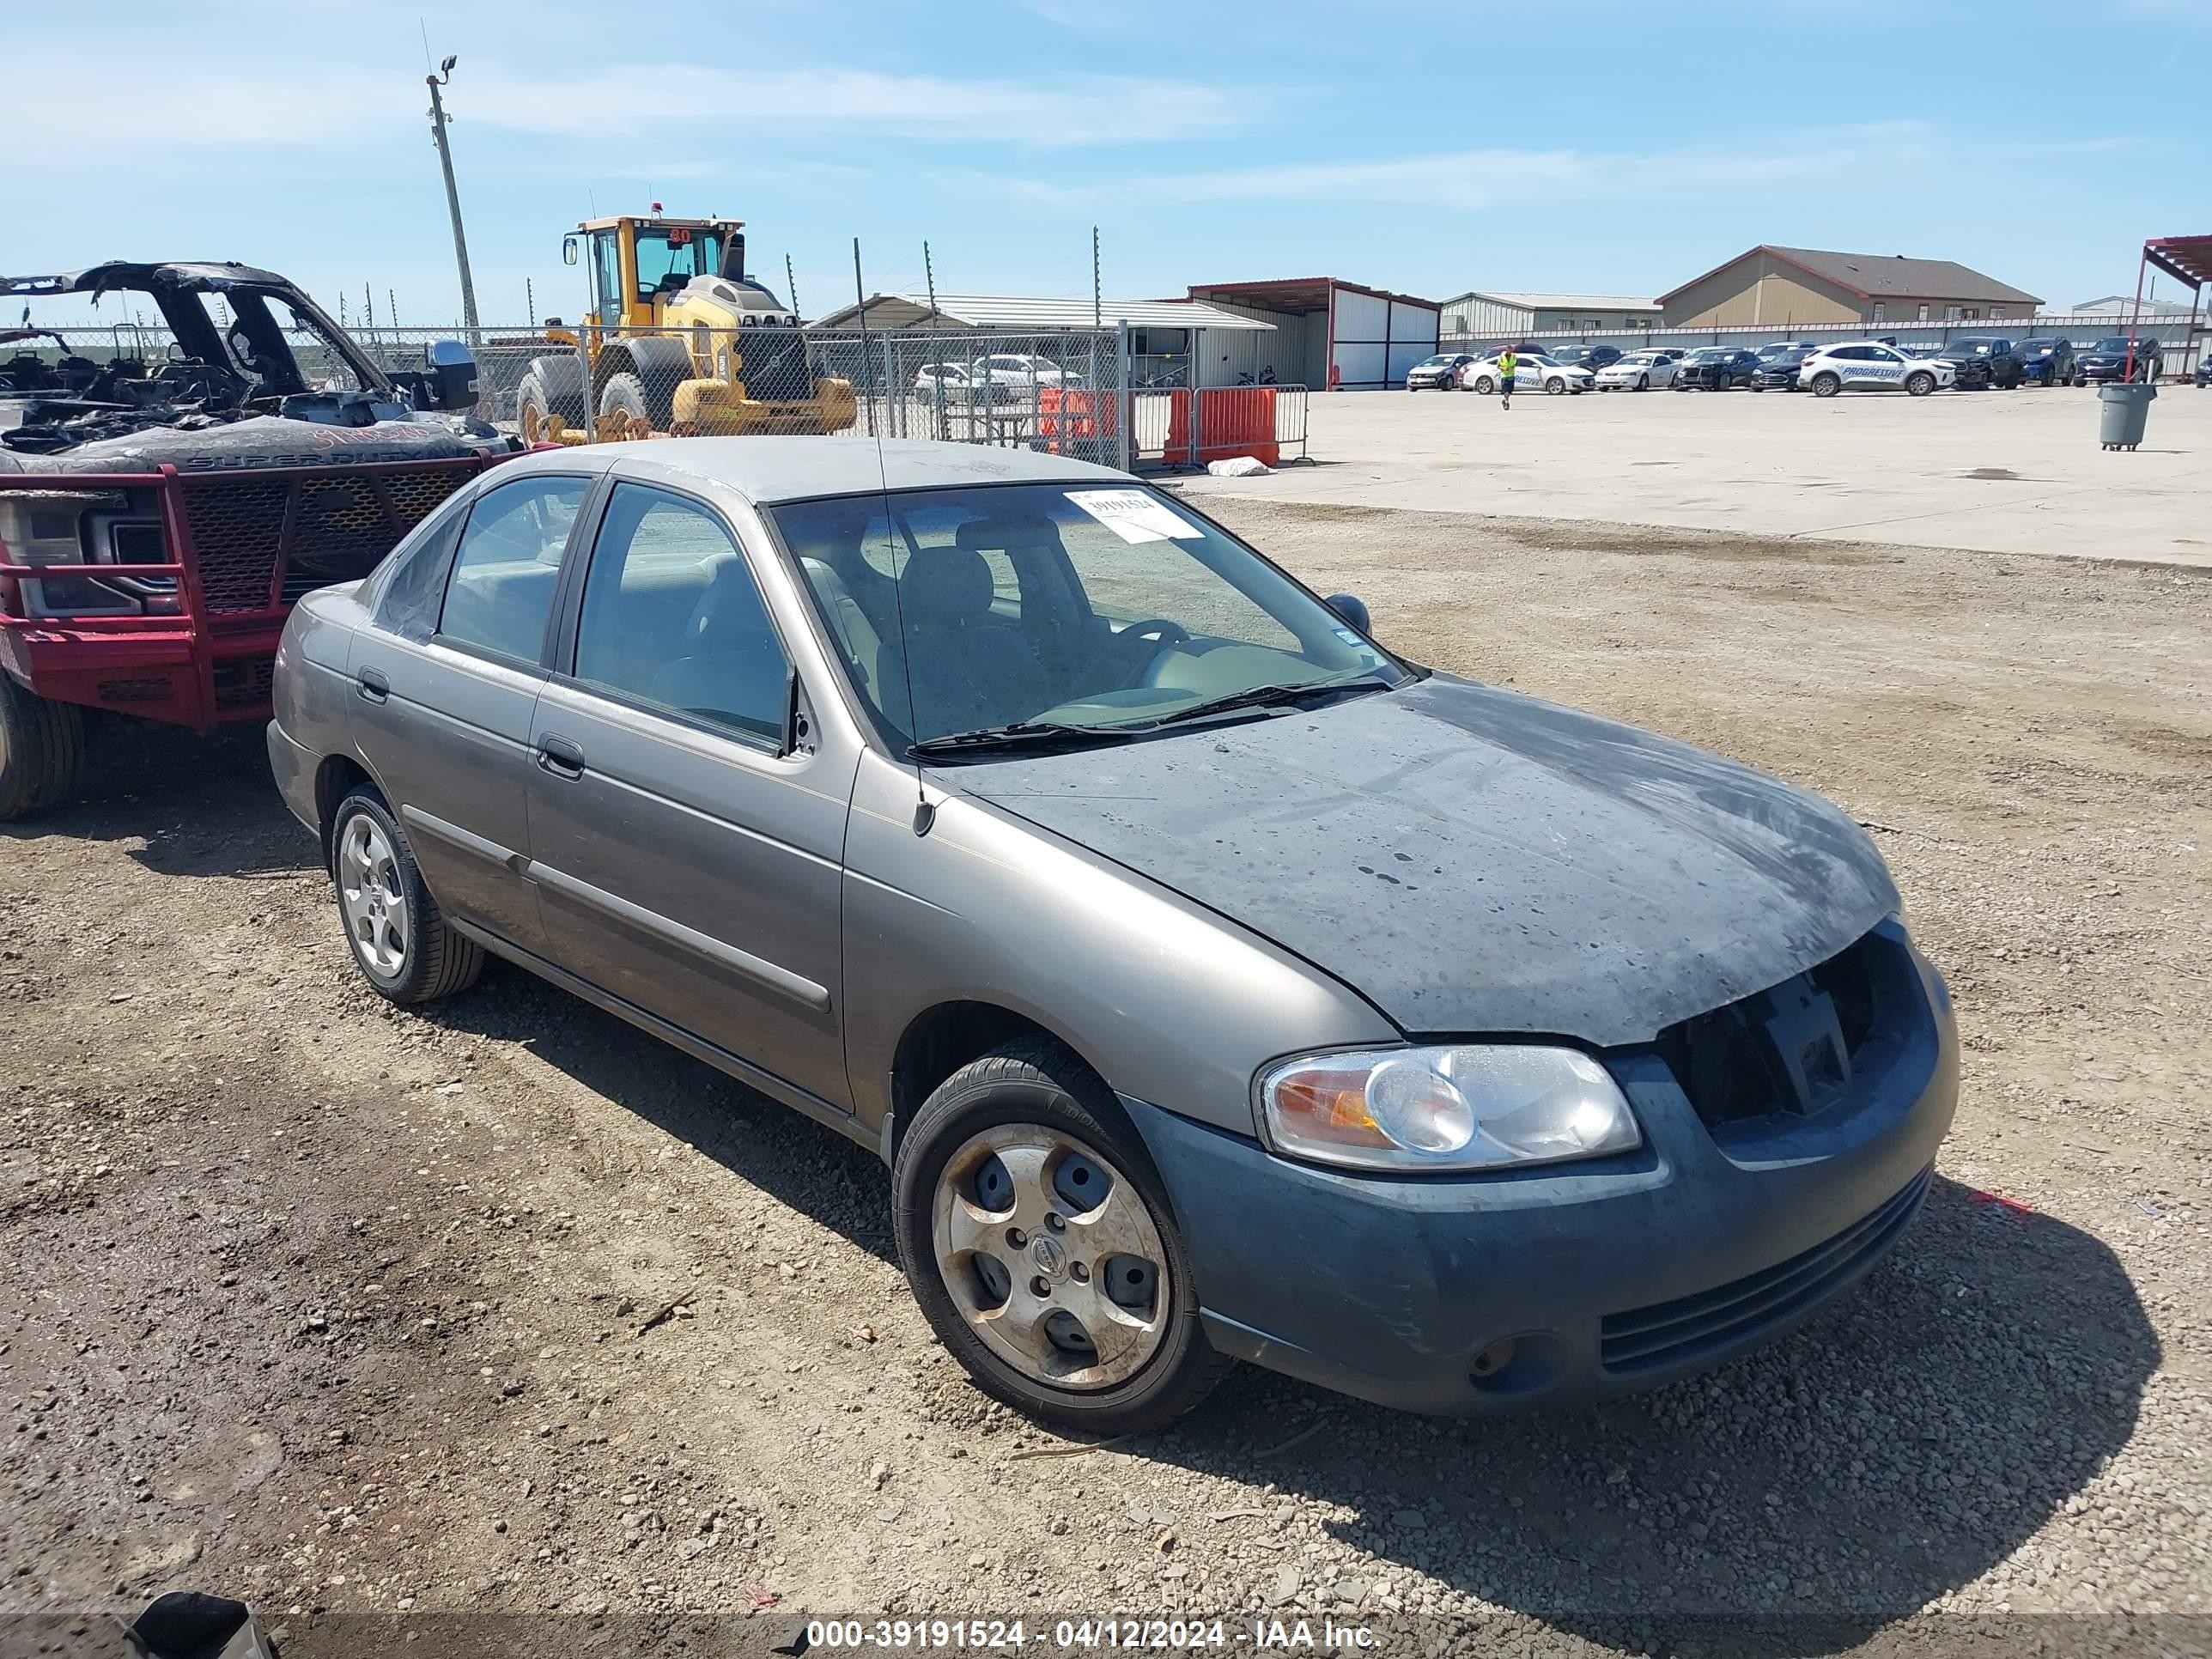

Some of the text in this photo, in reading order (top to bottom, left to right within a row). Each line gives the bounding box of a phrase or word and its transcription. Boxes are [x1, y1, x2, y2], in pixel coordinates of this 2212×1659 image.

[670, 228, 690, 243] 80
[1843, 367, 1904, 377] PROGRESSIVE
[186, 453, 325, 469] SUPER
[1088, 500, 1155, 513] 39191524
[1036, 1238, 1059, 1274] NISSAN
